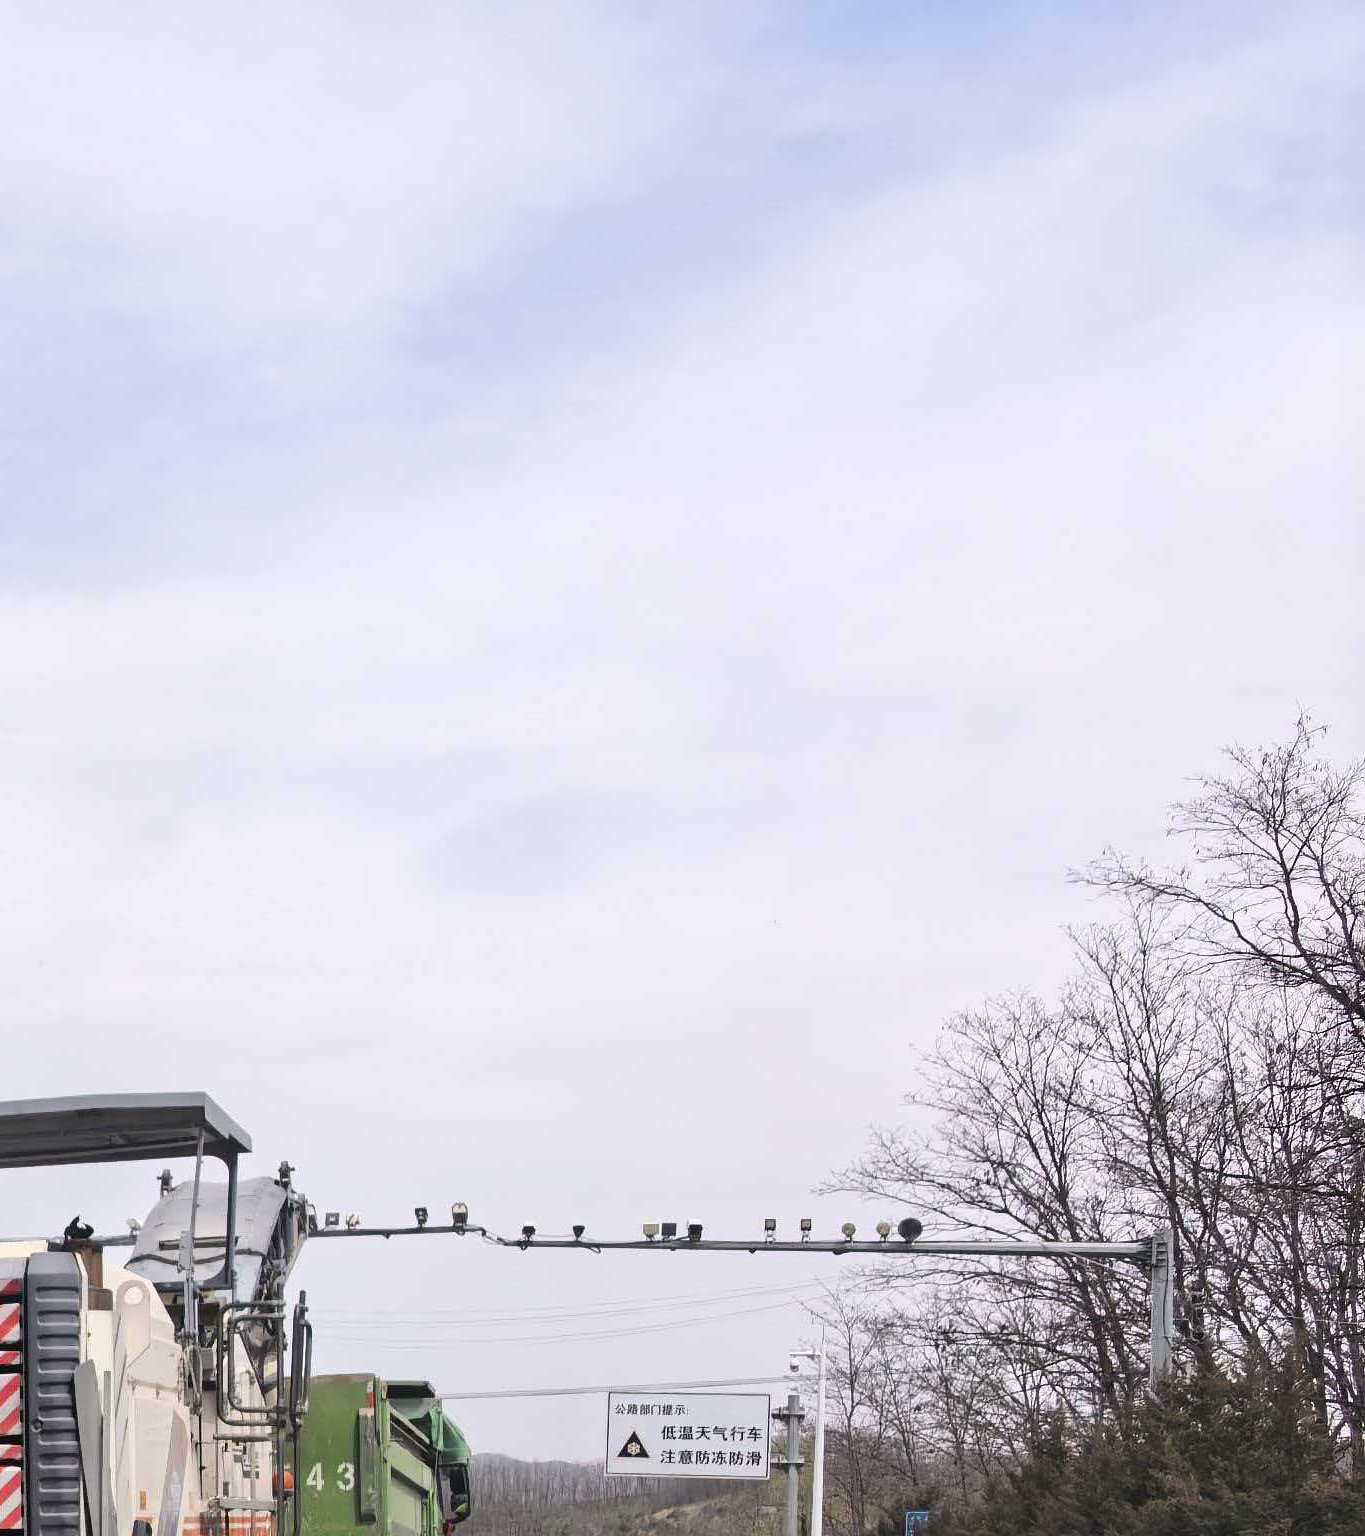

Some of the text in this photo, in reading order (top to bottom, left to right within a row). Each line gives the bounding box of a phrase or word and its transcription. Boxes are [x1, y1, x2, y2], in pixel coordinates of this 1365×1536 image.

[660, 1425, 763, 1442] 低温天气行车
[660, 1450, 762, 1466] 注意防冻防滑
